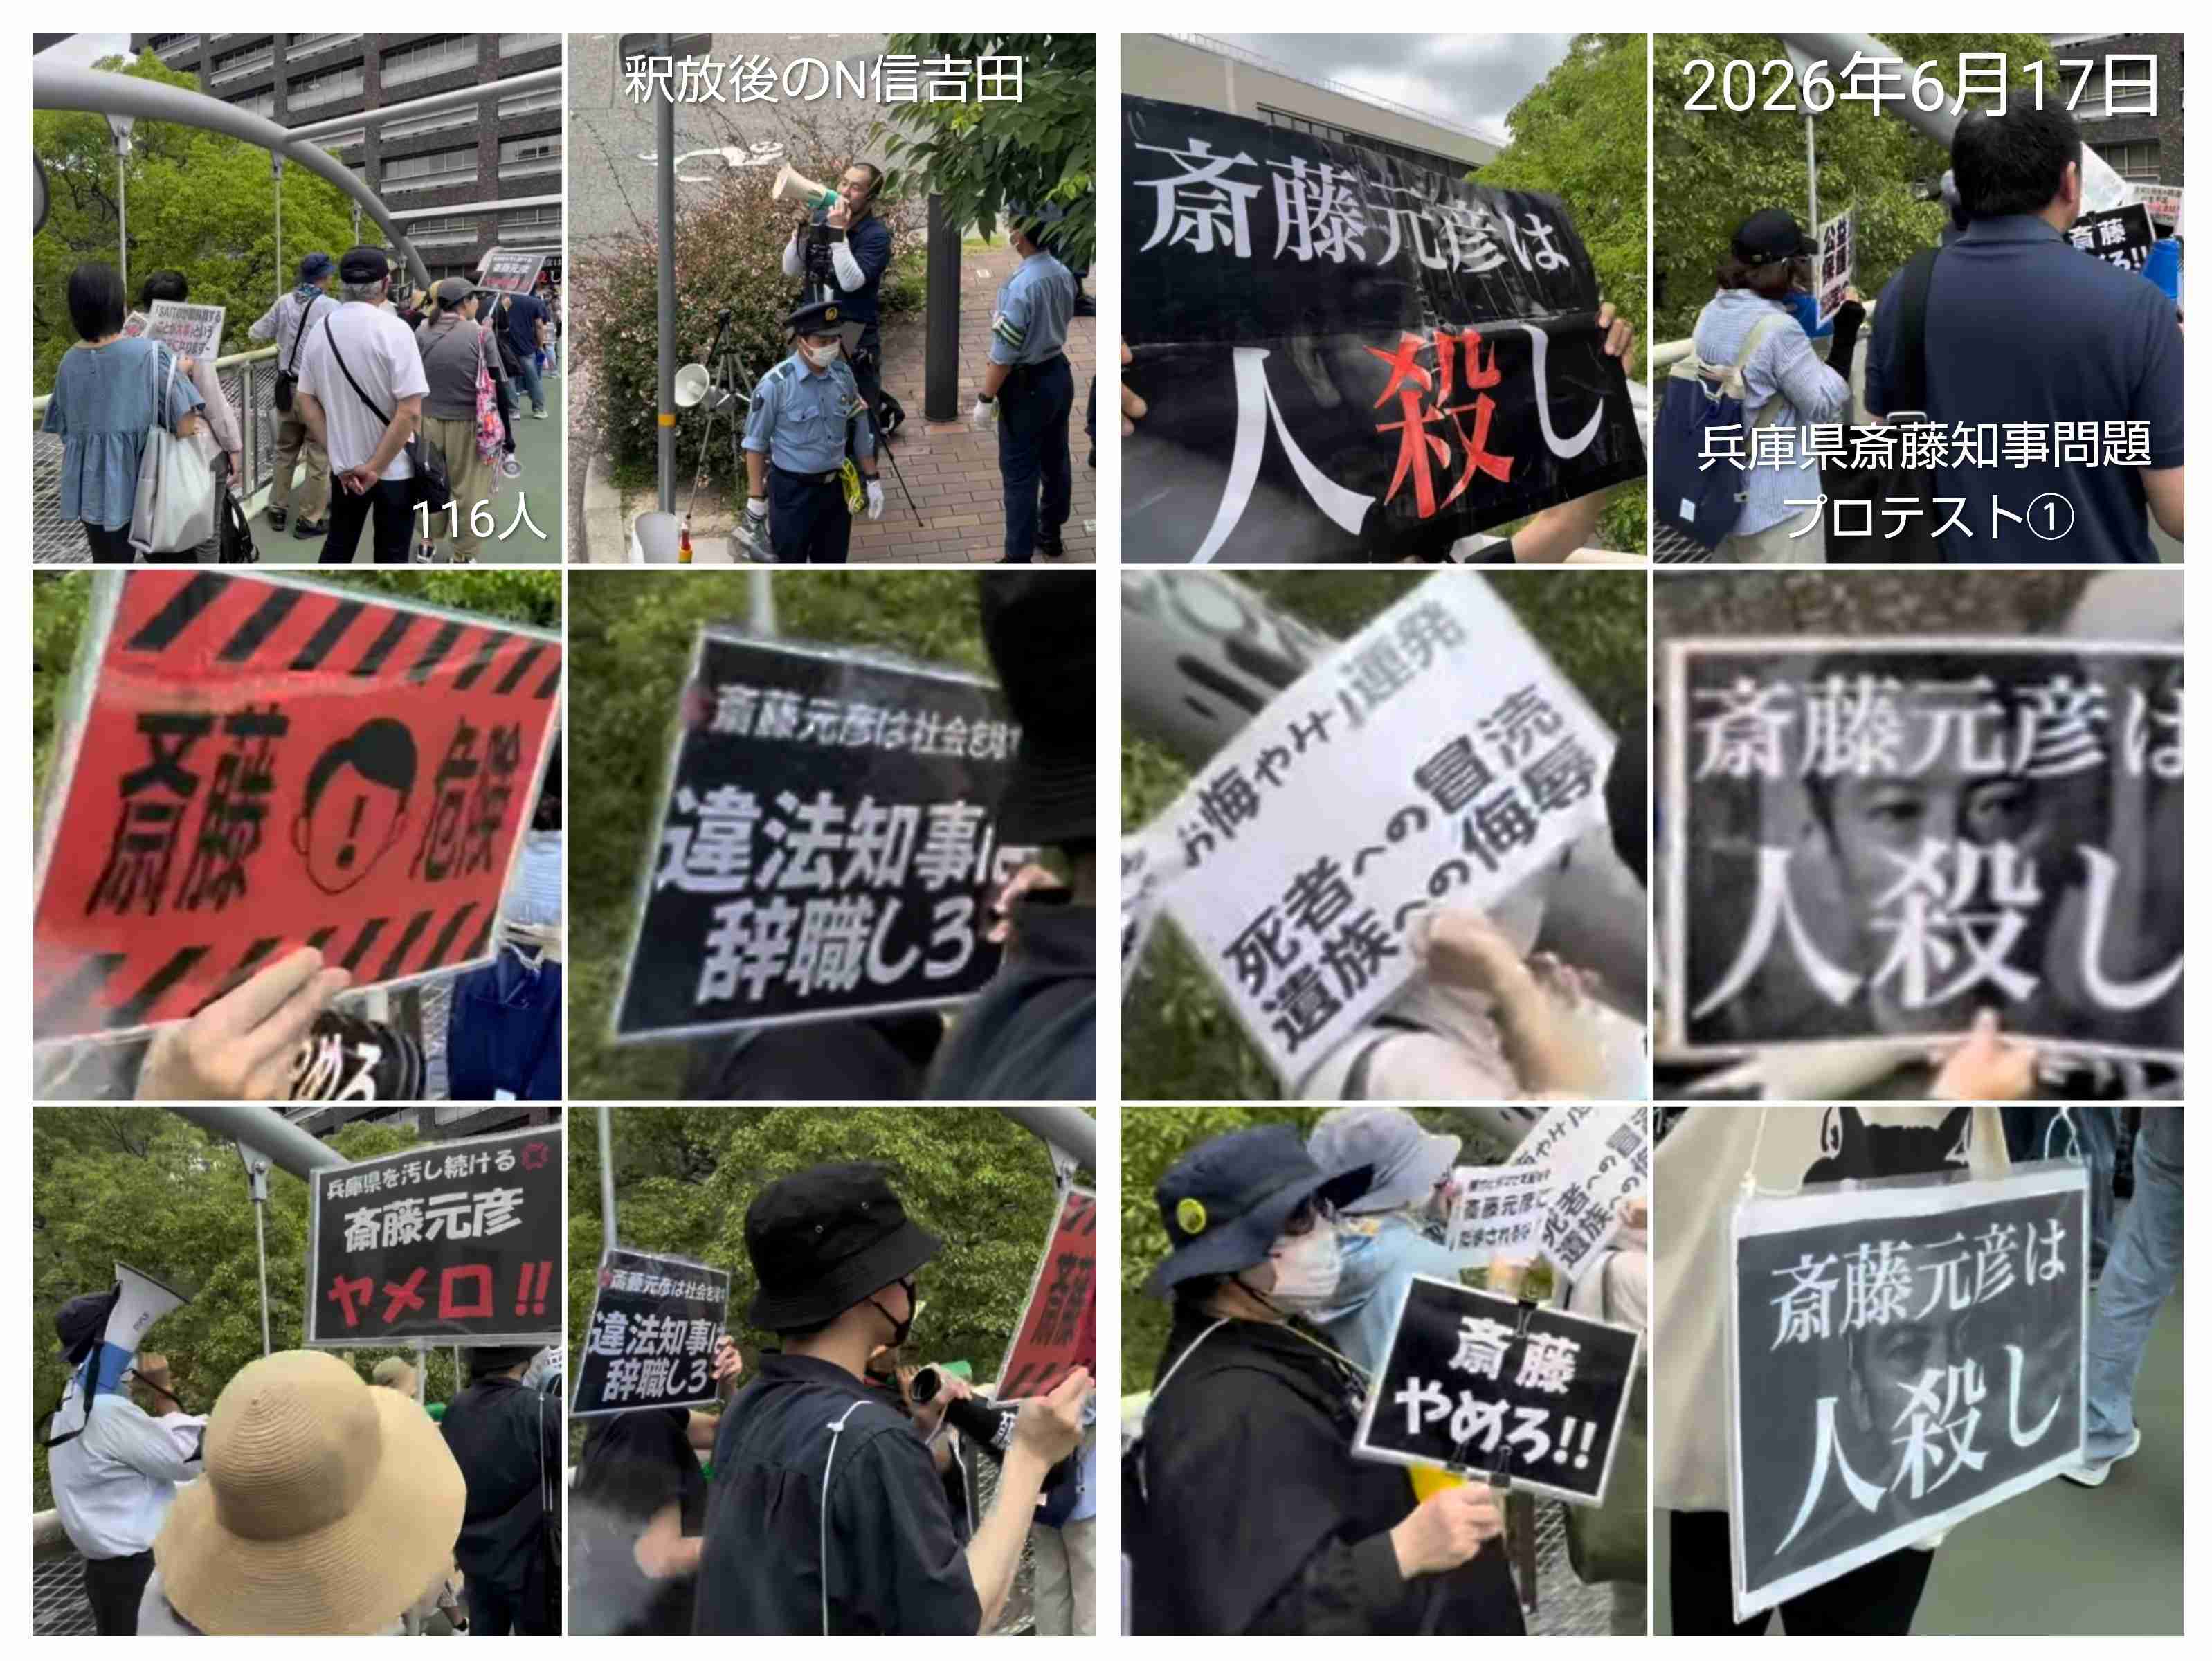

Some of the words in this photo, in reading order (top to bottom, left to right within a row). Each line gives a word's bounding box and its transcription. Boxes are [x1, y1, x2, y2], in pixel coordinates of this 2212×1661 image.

[1133, 138, 1570, 273] 斎藤元彦は
[1189, 323, 1604, 564] 人殺し
[1694, 673, 2184, 781] 斎藤元彦は
[410, 716, 522, 883] 危険
[695, 898, 976, 1006] 辞職しろ
[1260, 734, 1599, 1053] 遺族への侮辱
[1690, 837, 2184, 1020] 人殺し
[327, 1148, 516, 1201] 兵庫県を汚し続ける
[343, 1186, 525, 1253] 斎藤元彦
[1768, 1219, 2066, 1351] 斎藤元彦は
[601, 1356, 708, 1402] 辞職しろ
[1774, 1345, 2062, 1554] 人殺し
